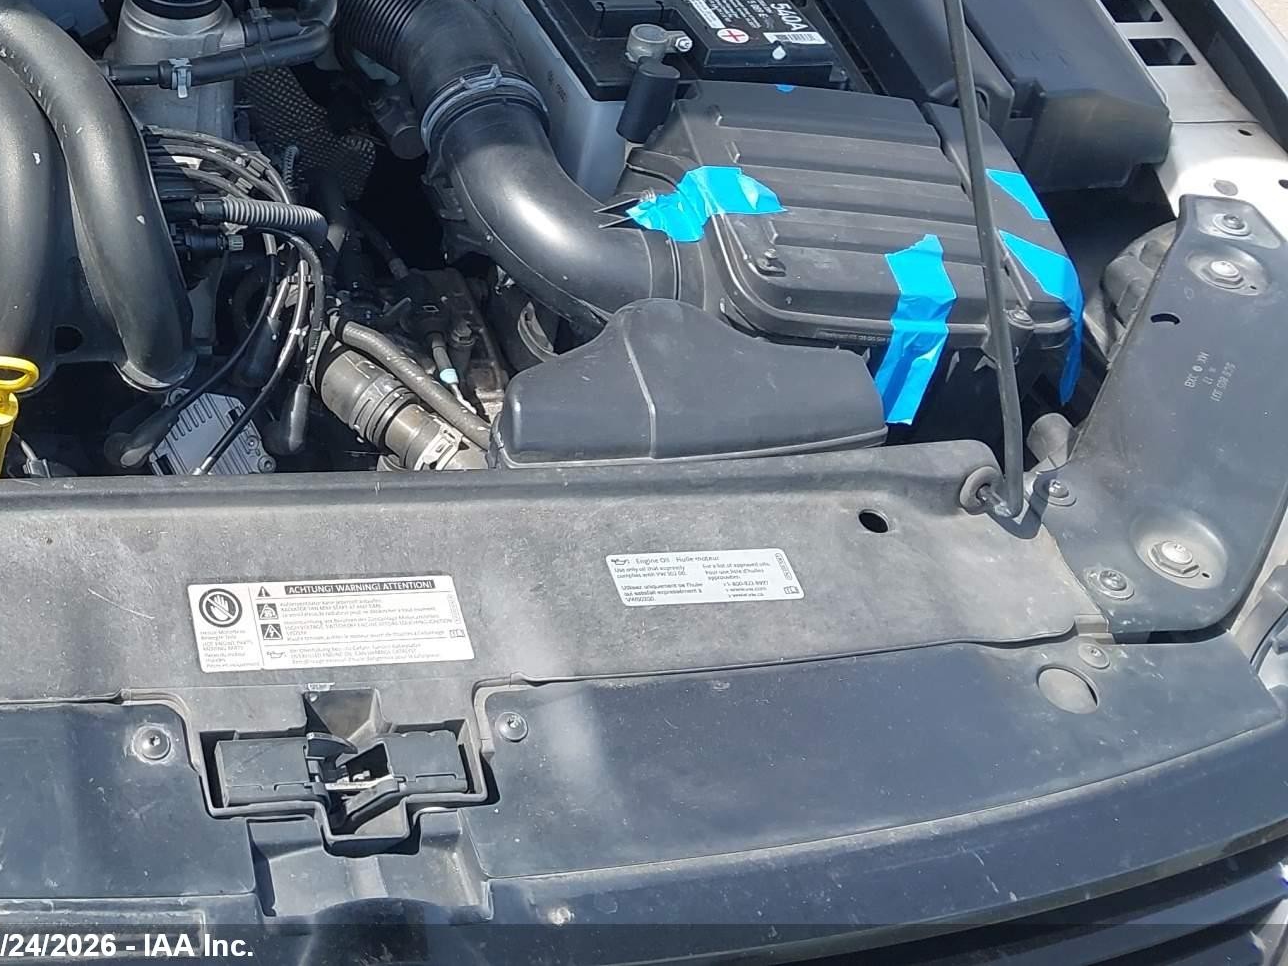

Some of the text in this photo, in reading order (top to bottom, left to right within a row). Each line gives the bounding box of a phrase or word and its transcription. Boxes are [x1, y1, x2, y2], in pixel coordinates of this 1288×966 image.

[289, 580, 433, 595] ACHTUNG! WARNING! ATTENTION!
